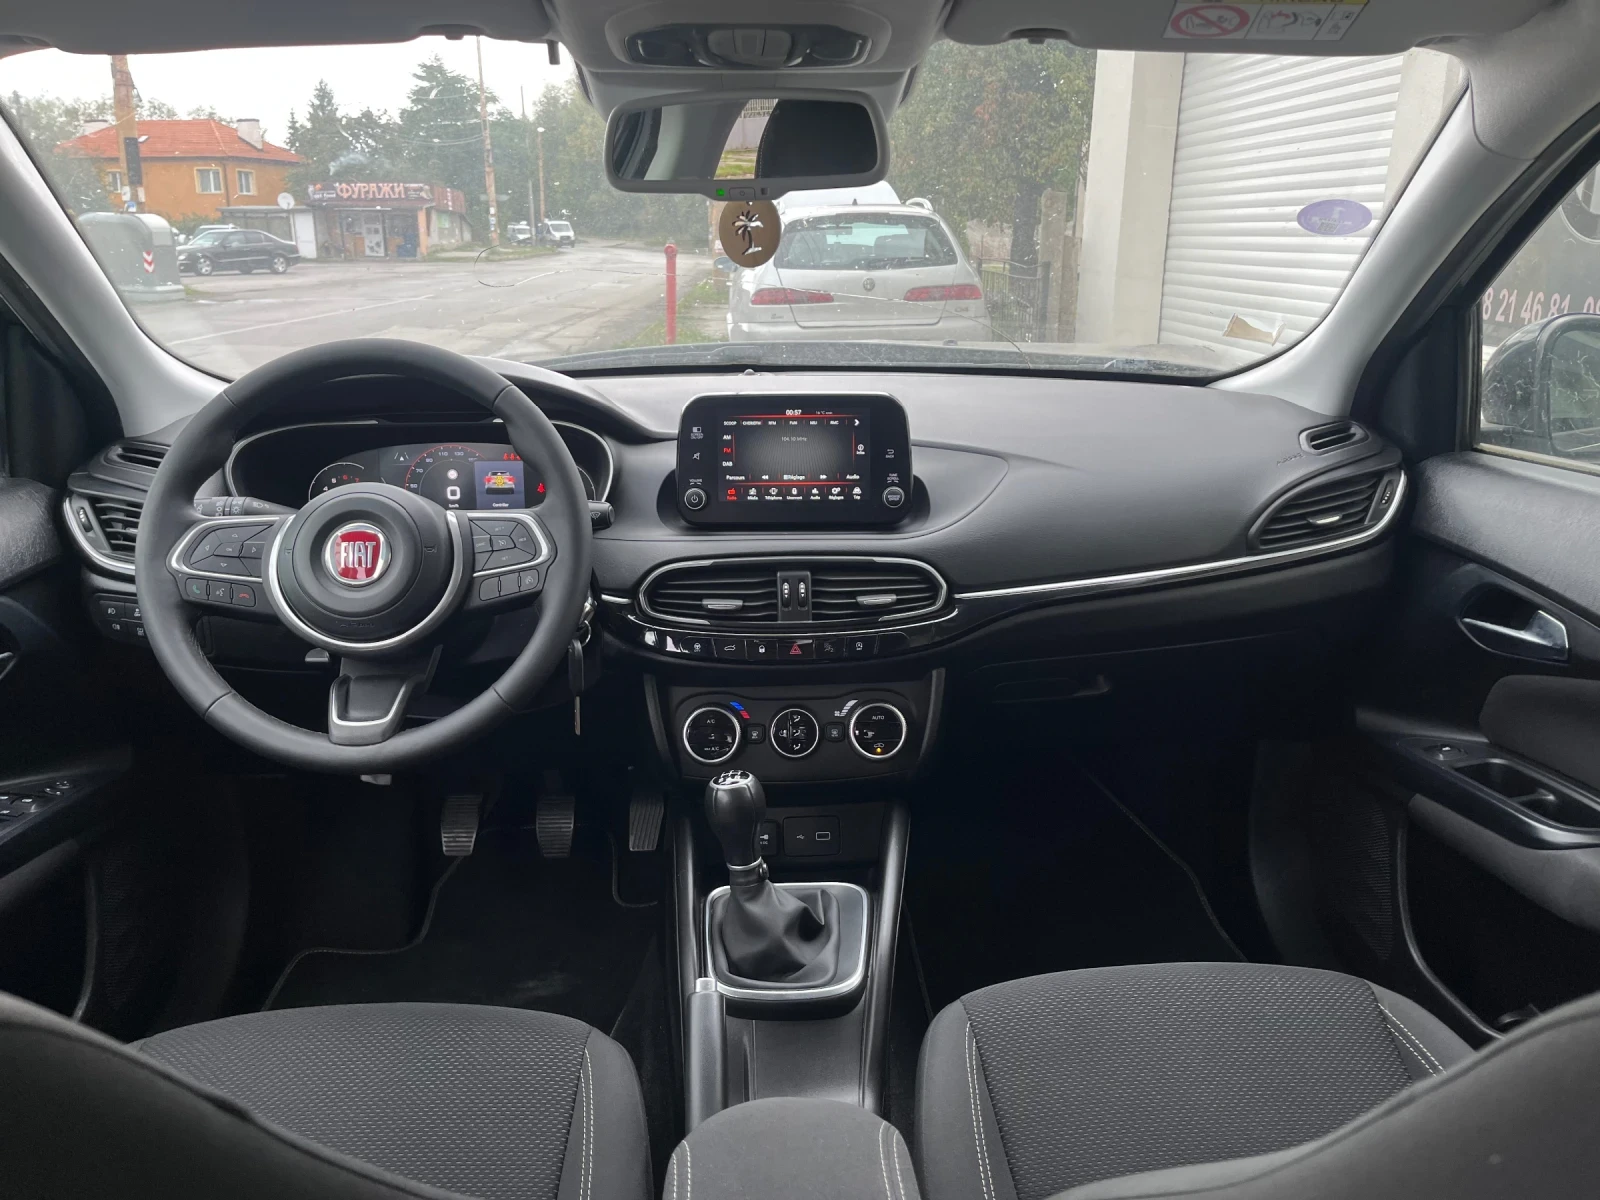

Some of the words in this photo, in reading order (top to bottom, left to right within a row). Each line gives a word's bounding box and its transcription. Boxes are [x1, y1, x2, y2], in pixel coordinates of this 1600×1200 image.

[337, 182, 406, 199] ФУРАЖИ
[1495, 288, 1518, 323] 21
[1520, 290, 1545, 325] 46
[340, 541, 377, 569] FIAT
